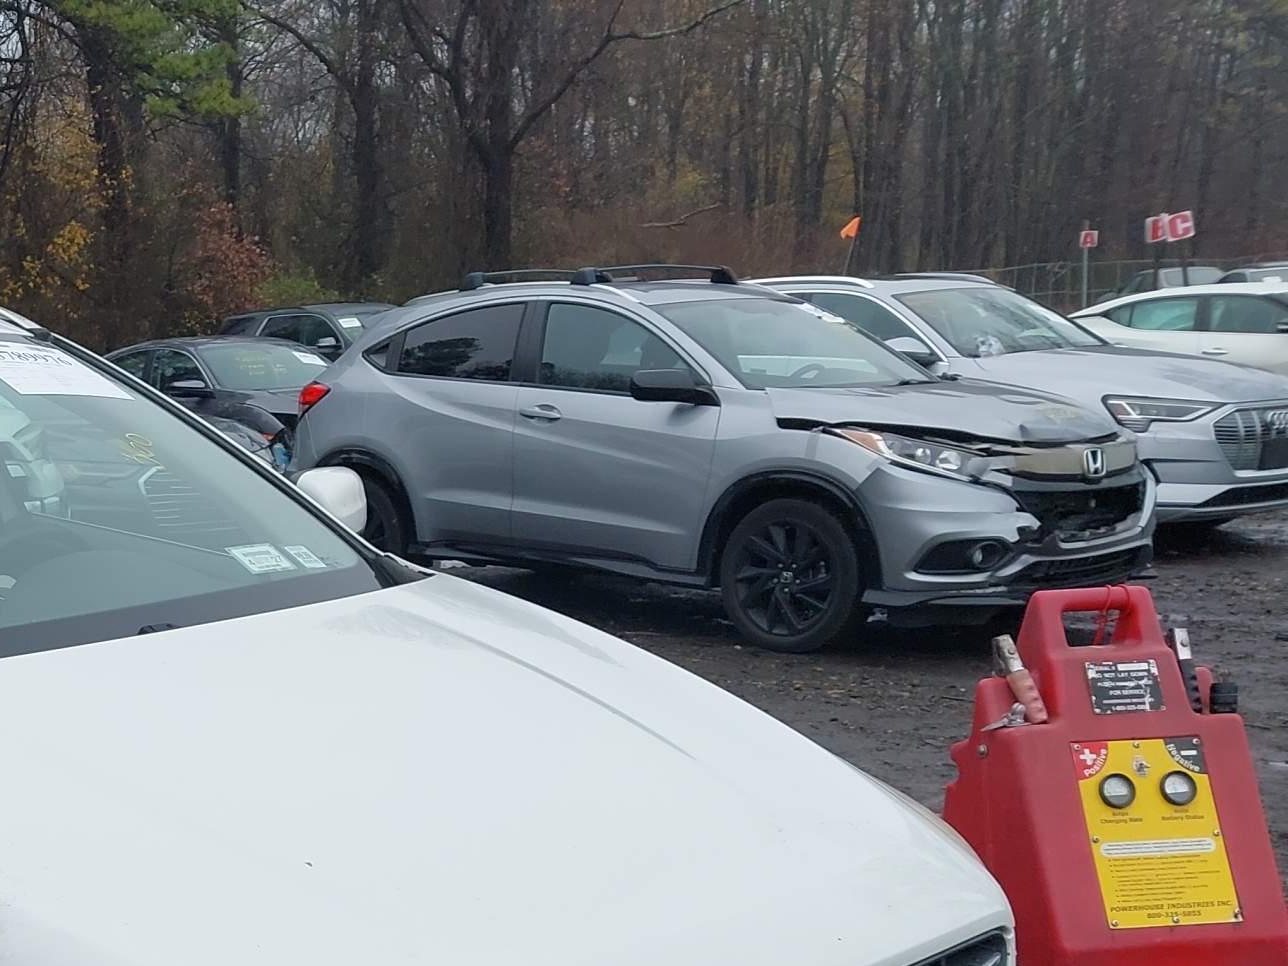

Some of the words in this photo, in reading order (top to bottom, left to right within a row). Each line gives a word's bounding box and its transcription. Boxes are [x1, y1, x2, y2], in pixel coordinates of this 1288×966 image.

[1168, 213, 1192, 237] C
[1083, 748, 1108, 778] Positive
[1166, 743, 1201, 773] Negative
[1110, 903, 1164, 913] POWERHOUSE
[1167, 901, 1215, 911] INDUSTRIES
